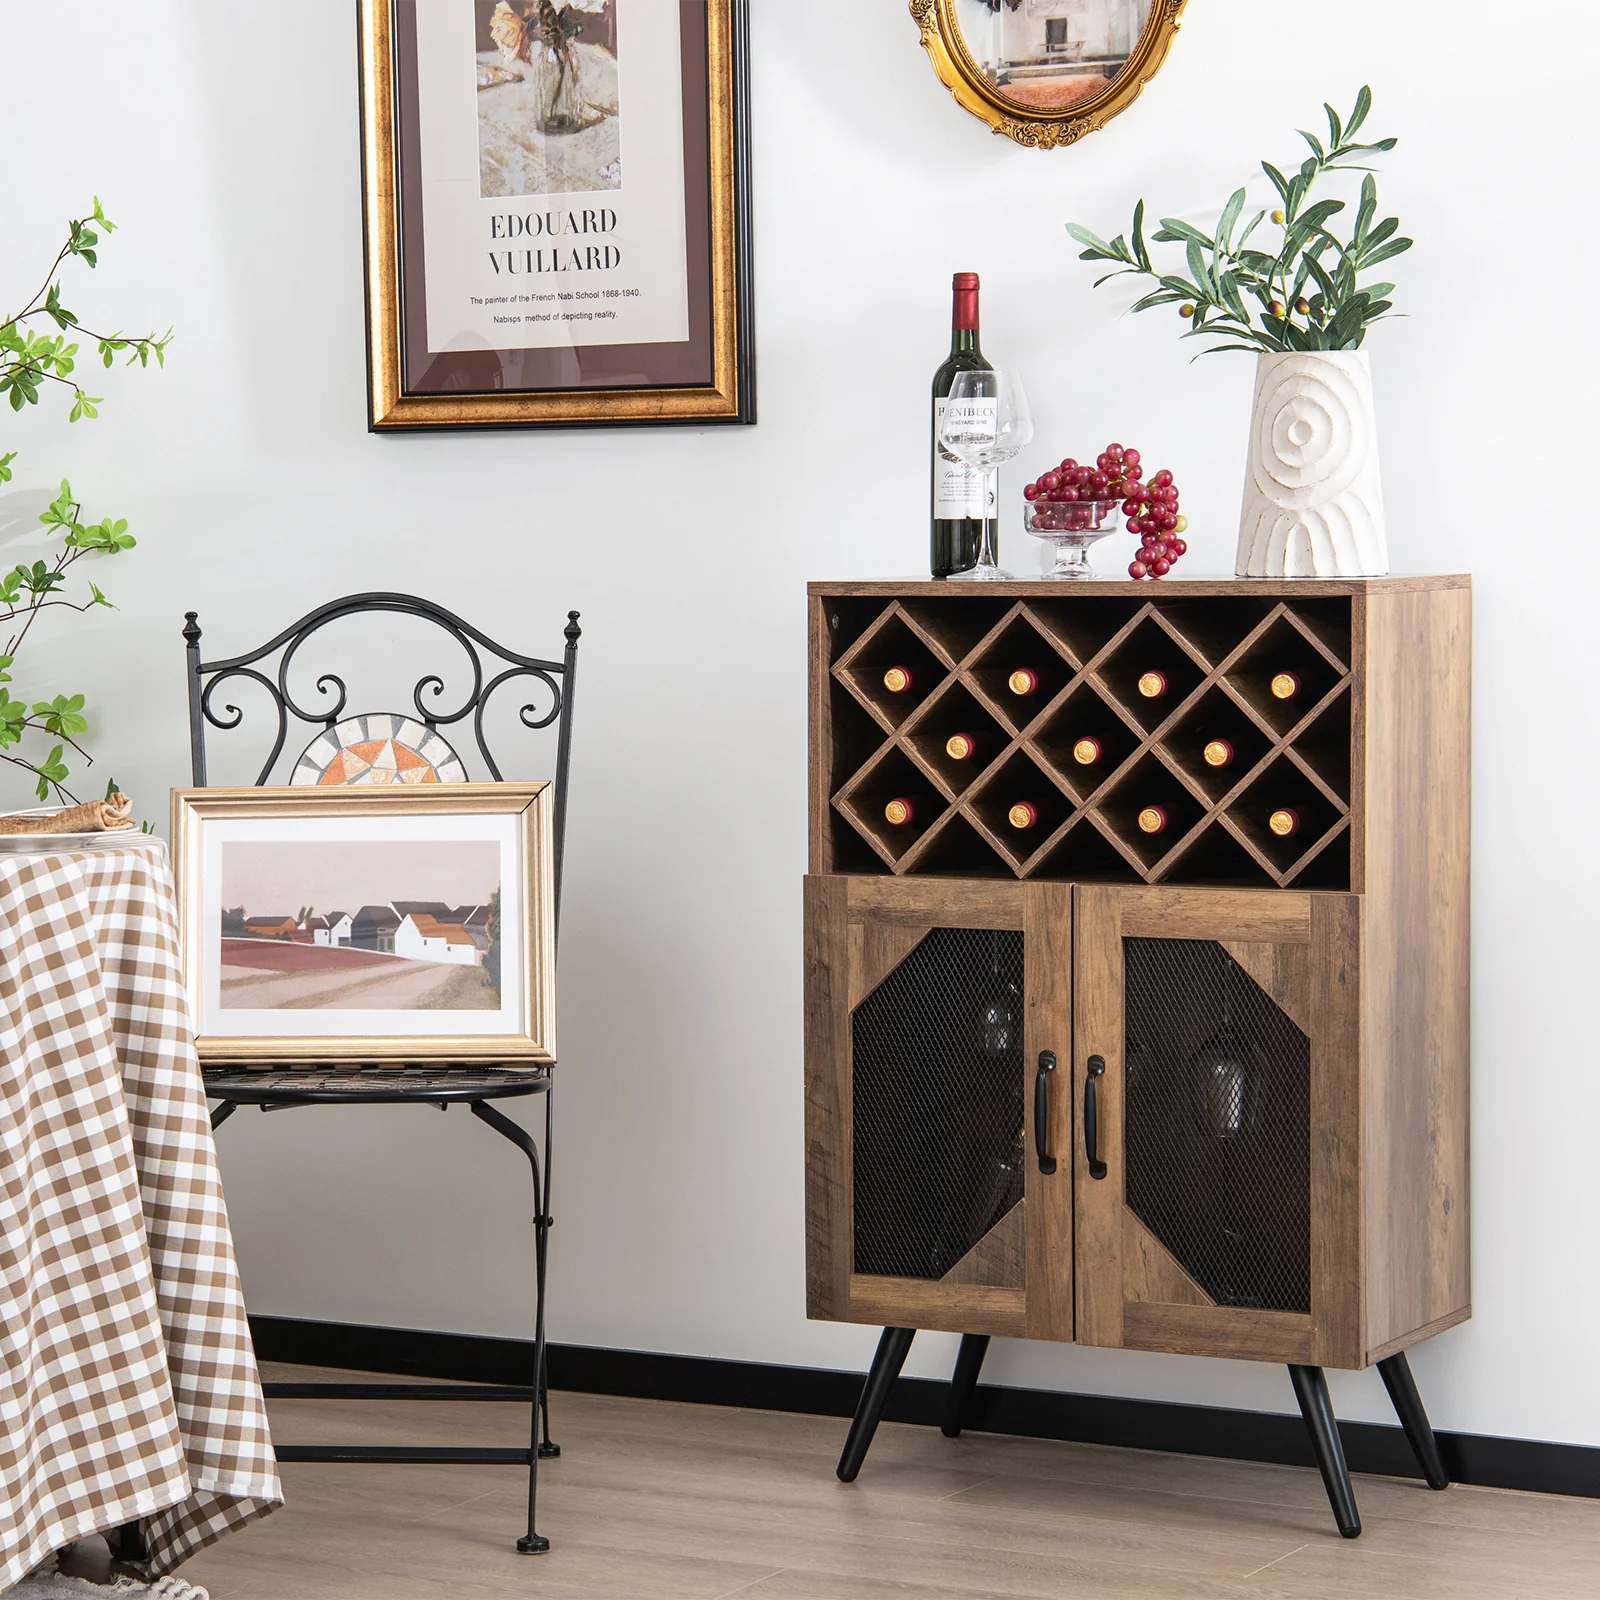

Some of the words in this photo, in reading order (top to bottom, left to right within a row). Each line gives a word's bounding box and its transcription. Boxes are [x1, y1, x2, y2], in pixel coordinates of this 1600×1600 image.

[490, 208, 617, 239] EDOUARD
[488, 245, 621, 275] VUILLARD
[470, 296, 483, 305] The
[485, 296, 508, 306] painter
[510, 294, 517, 303] of
[518, 294, 530, 303] the
[531, 293, 556, 302] French
[557, 291, 574, 301] Nabi
[575, 290, 600, 300] School
[602, 288, 642, 298] 1868-1940.
[493, 314, 521, 324] Nabisps
[525, 313, 551, 322] method
[552, 312, 560, 321] of
[561, 311, 593, 321] depicting
[594, 310, 619, 320] reality.
